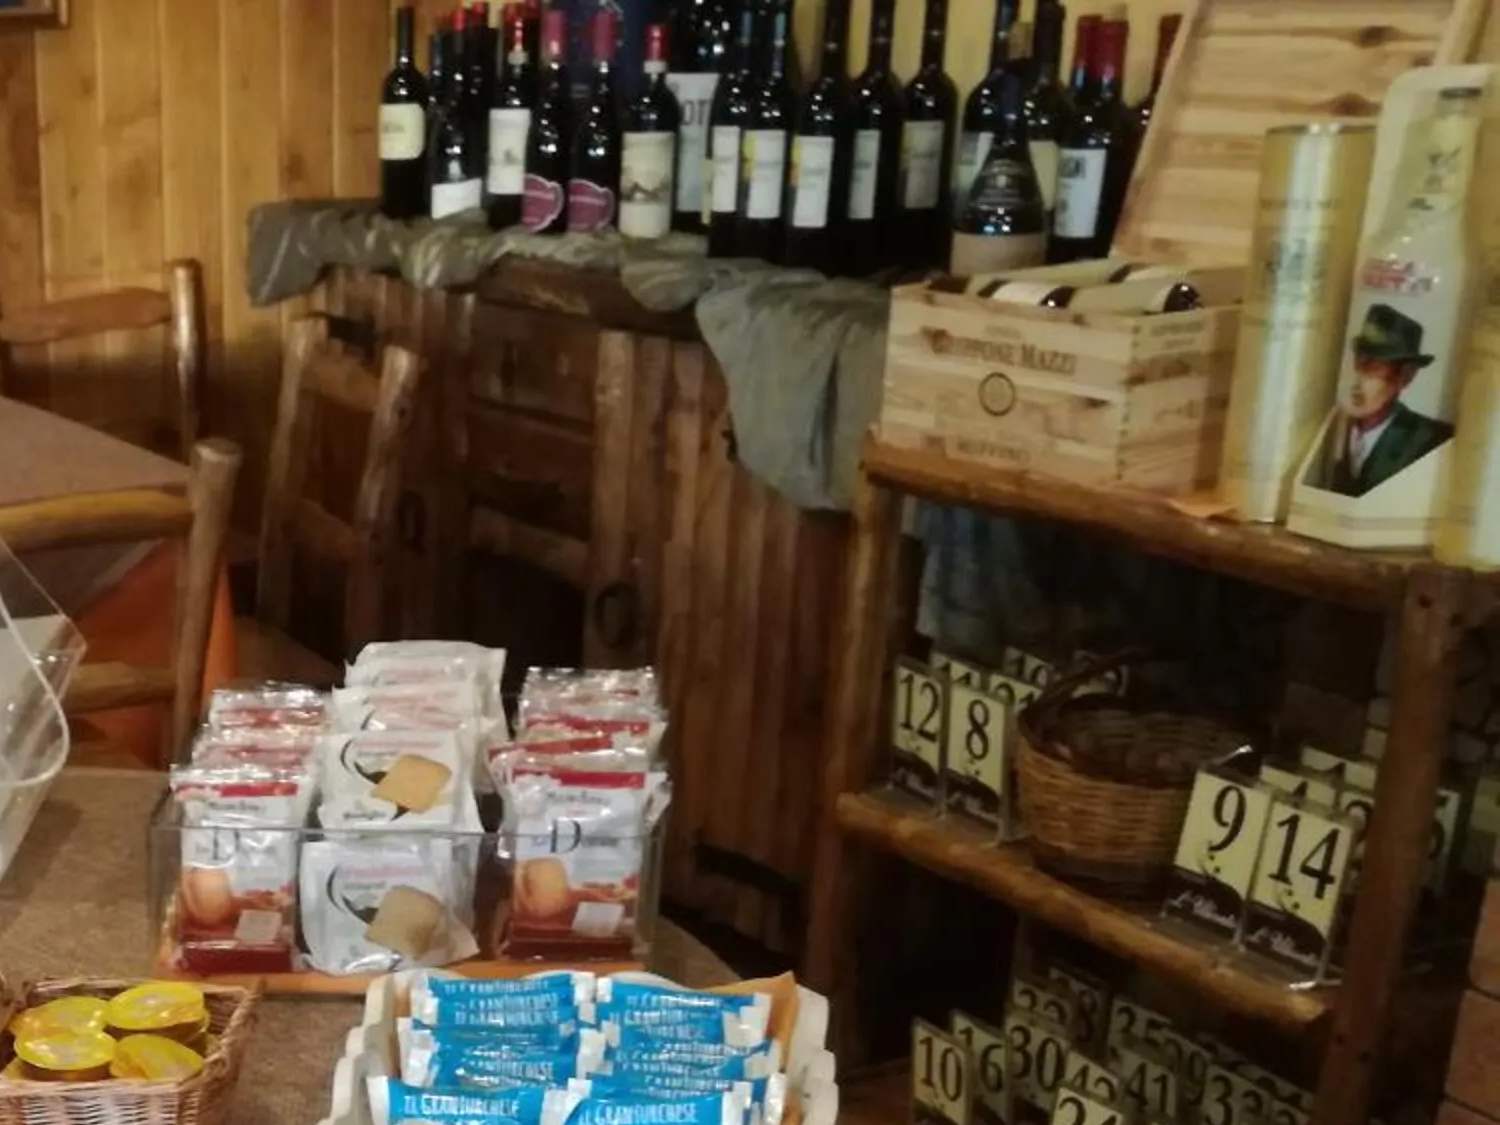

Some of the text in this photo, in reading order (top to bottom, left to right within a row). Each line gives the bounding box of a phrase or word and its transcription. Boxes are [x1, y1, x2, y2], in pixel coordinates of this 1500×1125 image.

[899, 673, 939, 742] 12
[966, 699, 989, 760] 8
[1208, 785, 1247, 852] 9
[1268, 813, 1340, 900] 14
[919, 1037, 962, 1102] 10
[1011, 1024, 1064, 1093] 30
